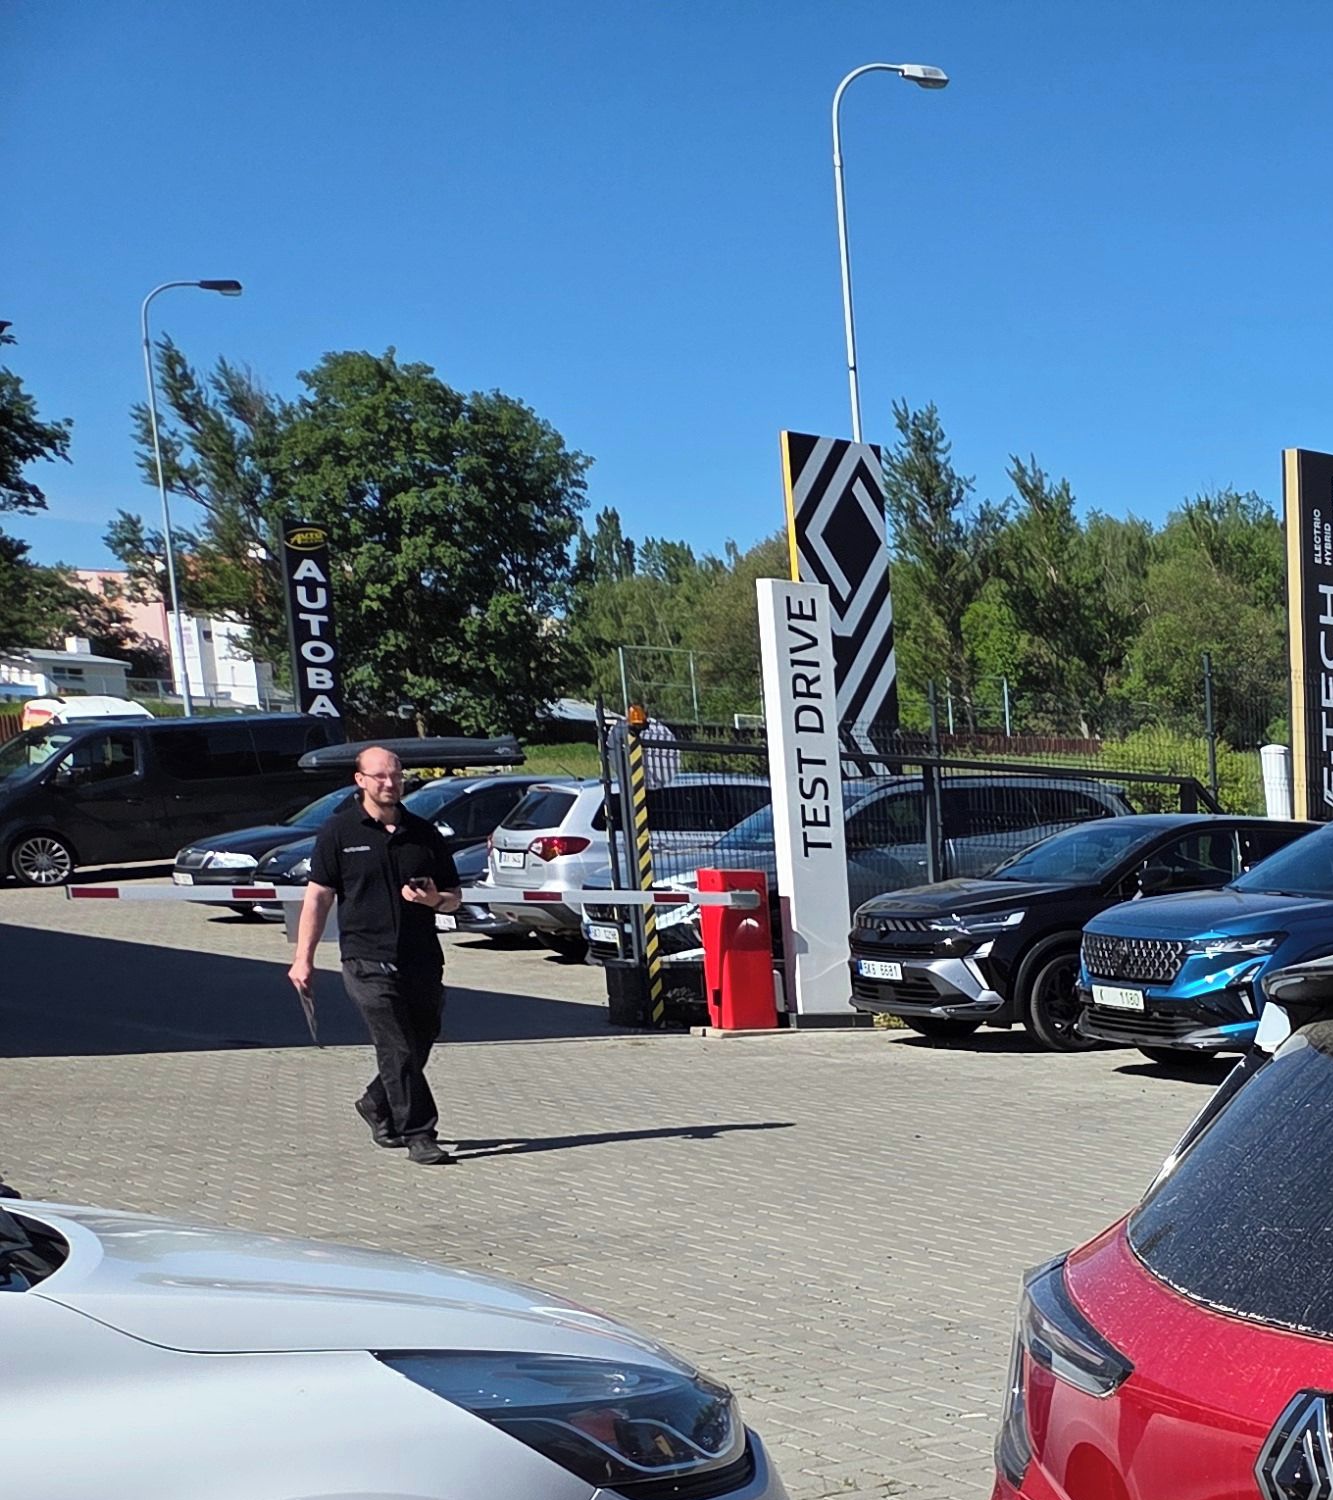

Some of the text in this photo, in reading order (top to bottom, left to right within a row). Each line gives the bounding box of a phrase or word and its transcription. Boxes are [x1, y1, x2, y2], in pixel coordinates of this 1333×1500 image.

[1312, 508, 1322, 565] ELECTRIC
[1323, 522, 1332, 566] HYBRID
[292, 558, 341, 718] AUTOBA
[785, 595, 833, 858] TEST DRIVE
